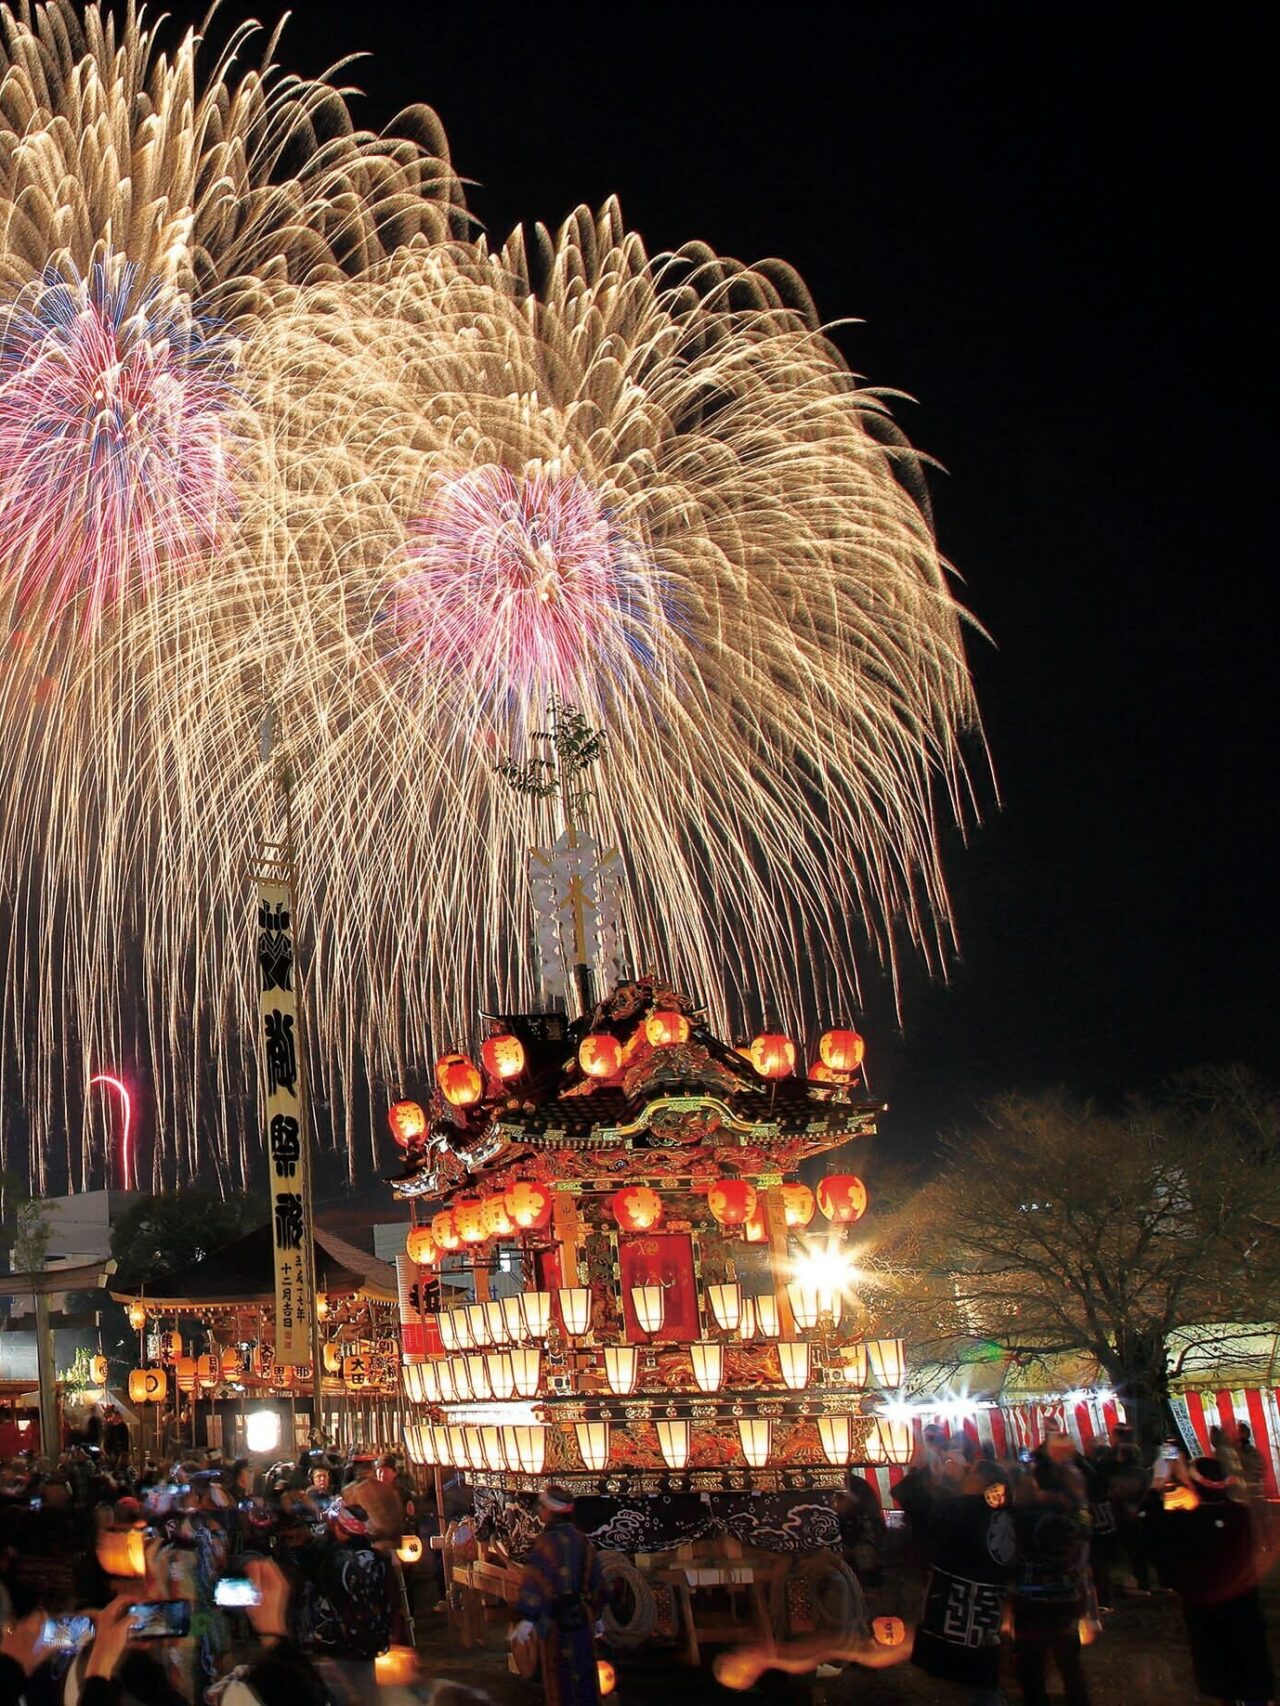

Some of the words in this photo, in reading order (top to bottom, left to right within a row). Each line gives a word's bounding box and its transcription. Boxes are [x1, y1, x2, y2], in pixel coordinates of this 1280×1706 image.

[281, 1263, 294, 1328] 十二月吉日
[351, 1359, 365, 1384] 大田
